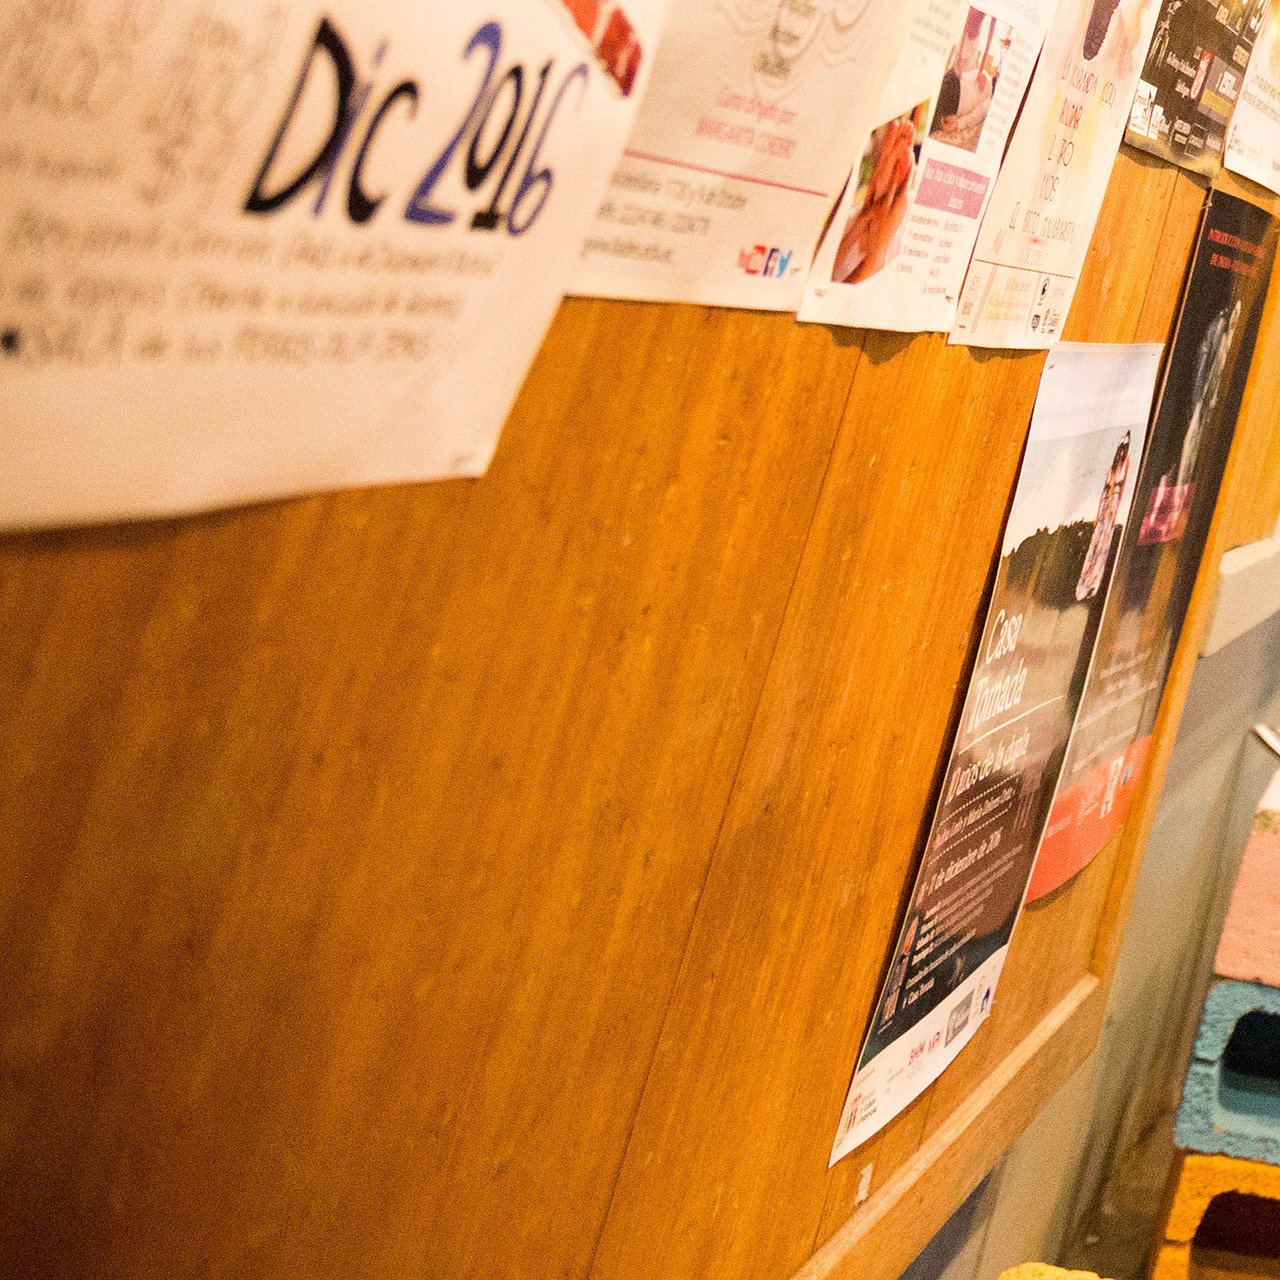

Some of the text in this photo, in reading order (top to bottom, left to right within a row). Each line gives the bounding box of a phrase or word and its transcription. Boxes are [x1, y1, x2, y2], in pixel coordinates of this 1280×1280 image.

[236, 8, 423, 231] Dic
[399, 15, 591, 239] 2016
[985, 608, 1023, 666] Casa
[966, 664, 1028, 736] Tomada
